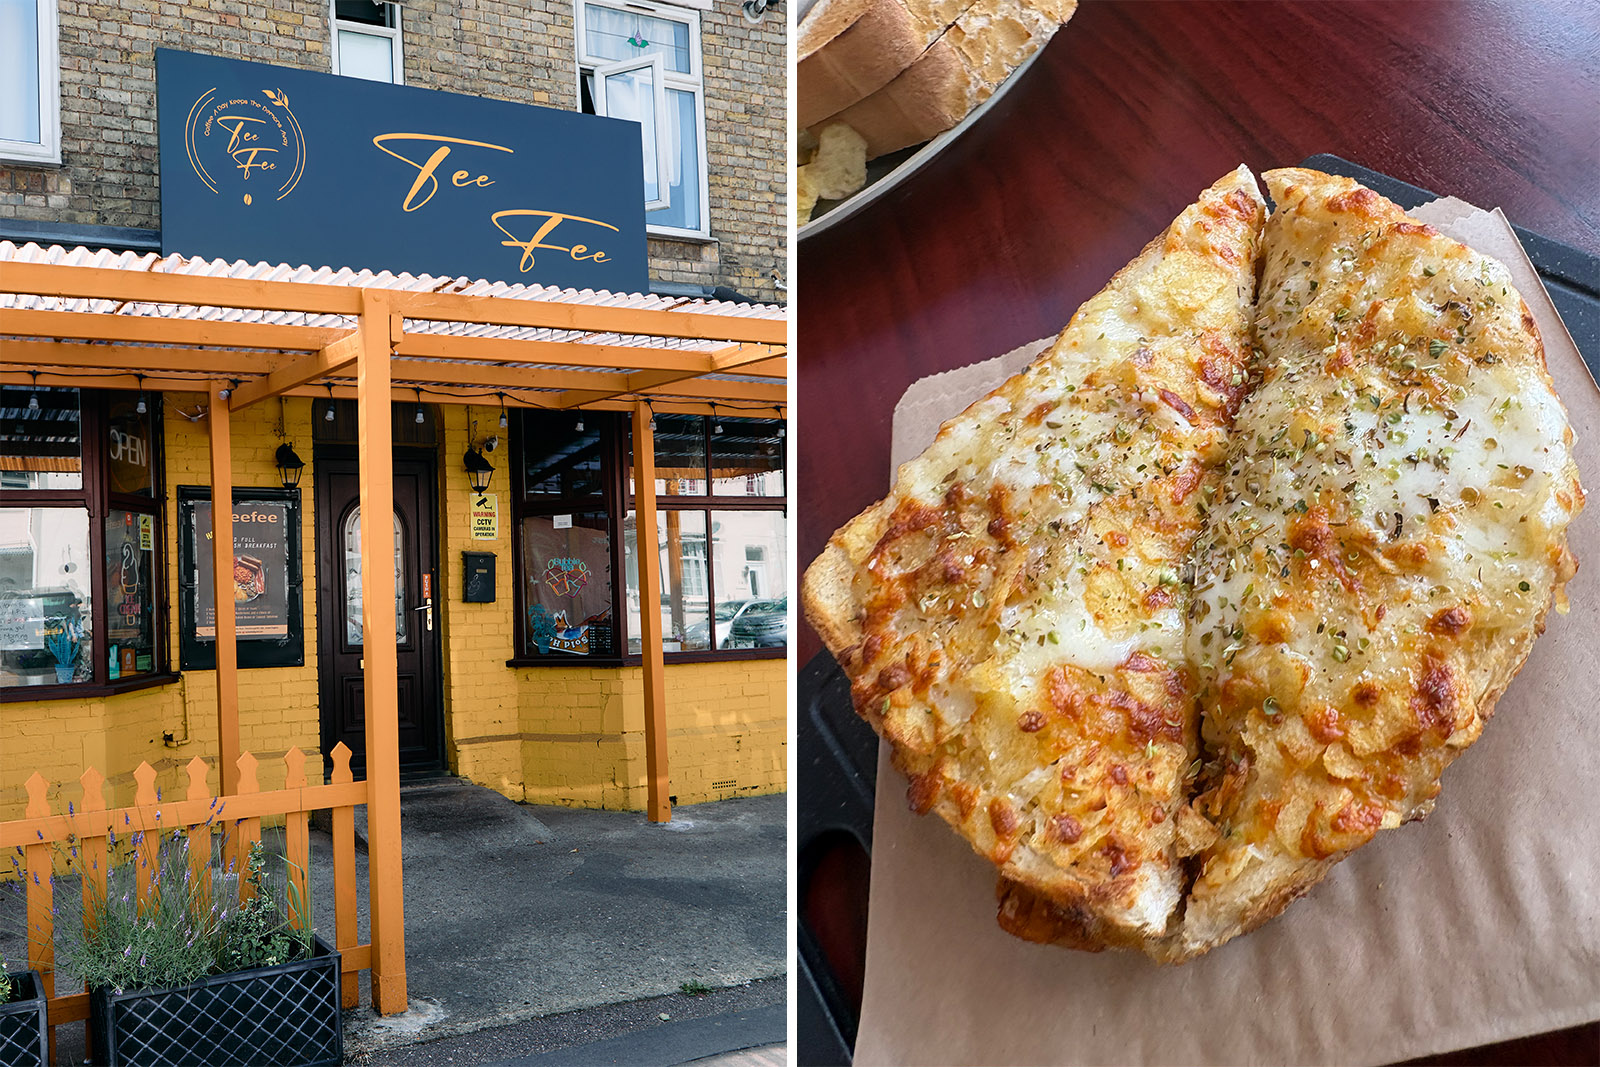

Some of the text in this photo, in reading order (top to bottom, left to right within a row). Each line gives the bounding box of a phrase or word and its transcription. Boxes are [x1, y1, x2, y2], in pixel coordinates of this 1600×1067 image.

[204, 115, 214, 136] Coffee
[216, 102, 229, 111] Day
[250, 99, 262, 108] The
[217, 115, 266, 154] Tee
[232, 147, 279, 180] Fee
[373, 132, 514, 212] Tee
[491, 209, 620, 273] Fee
[110, 428, 146, 467] OPEN
[231, 511, 278, 523] eefee
[476, 518, 492, 526] CCTV
[553, 557, 580, 567] Bubble
